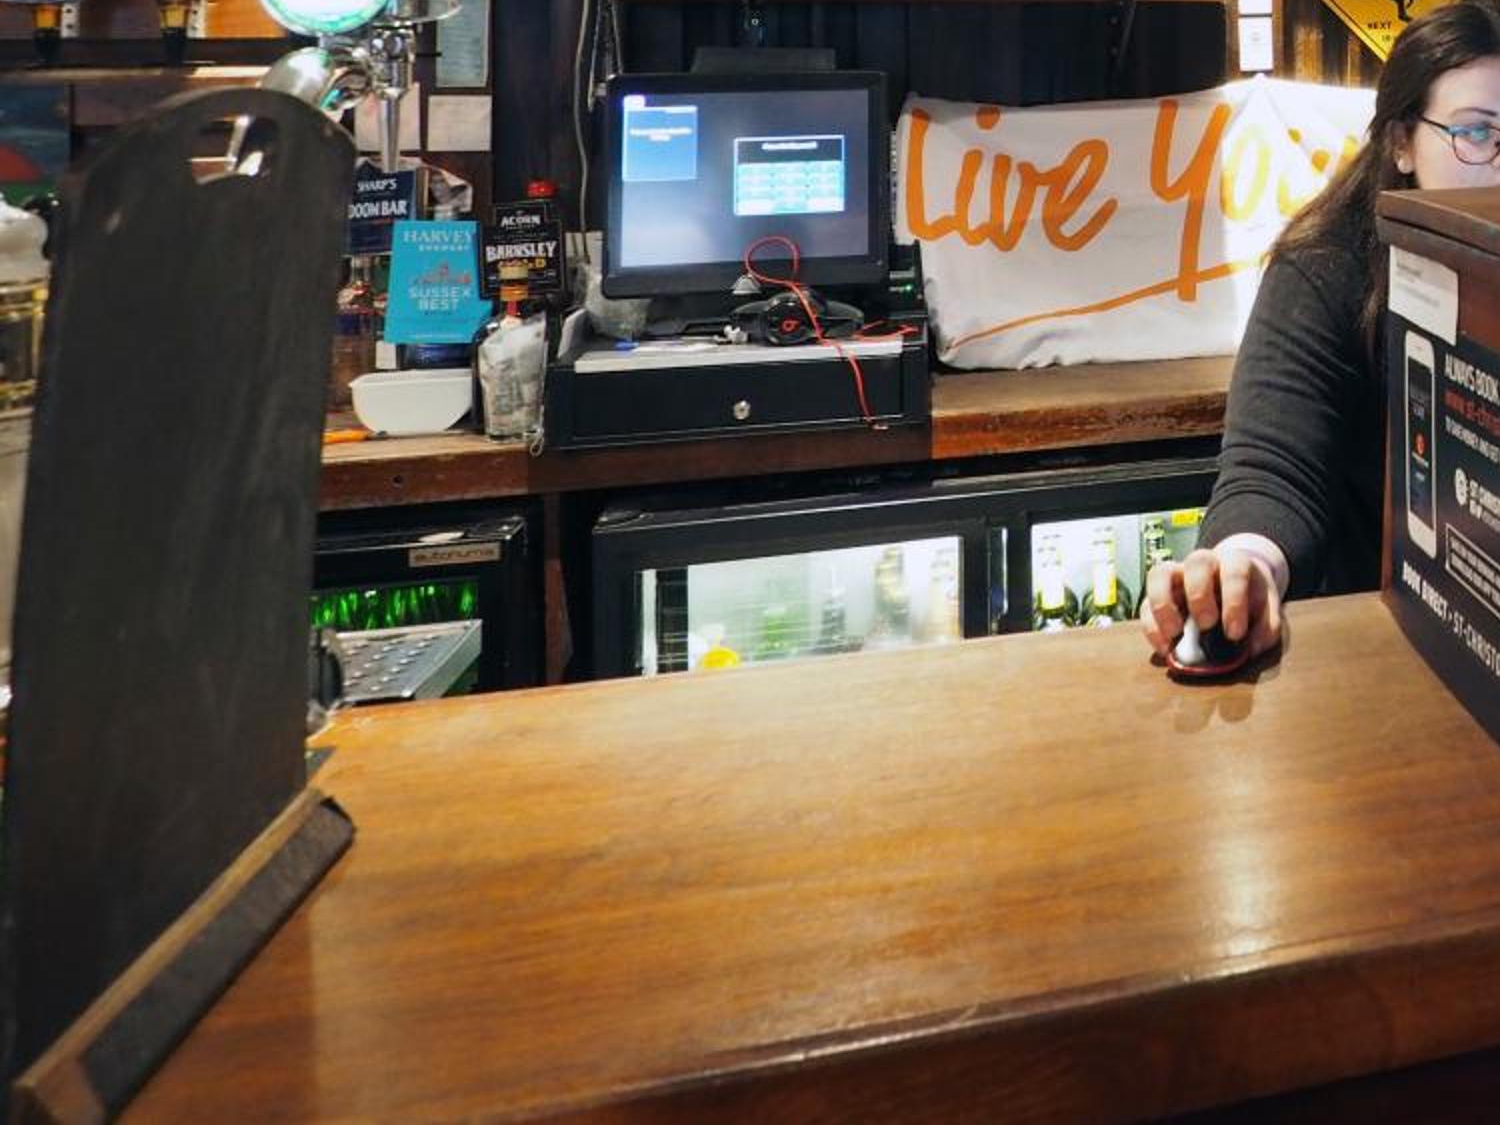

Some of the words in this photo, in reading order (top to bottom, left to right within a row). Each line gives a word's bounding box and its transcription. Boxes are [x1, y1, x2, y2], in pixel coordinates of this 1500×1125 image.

[357, 178, 398, 192] SHARP'S
[906, 105, 1118, 253] Live
[380, 200, 408, 216] BAR
[501, 215, 541, 228] ACORN
[485, 241, 557, 263] BARNSLEY
[409, 286, 472, 299] SUSSEX
[419, 298, 459, 311] BEST
[1445, 352, 1475, 392] ALWAYS
[1475, 368, 1500, 406] BOOK
[1421, 579, 1449, 621] DIRECT
